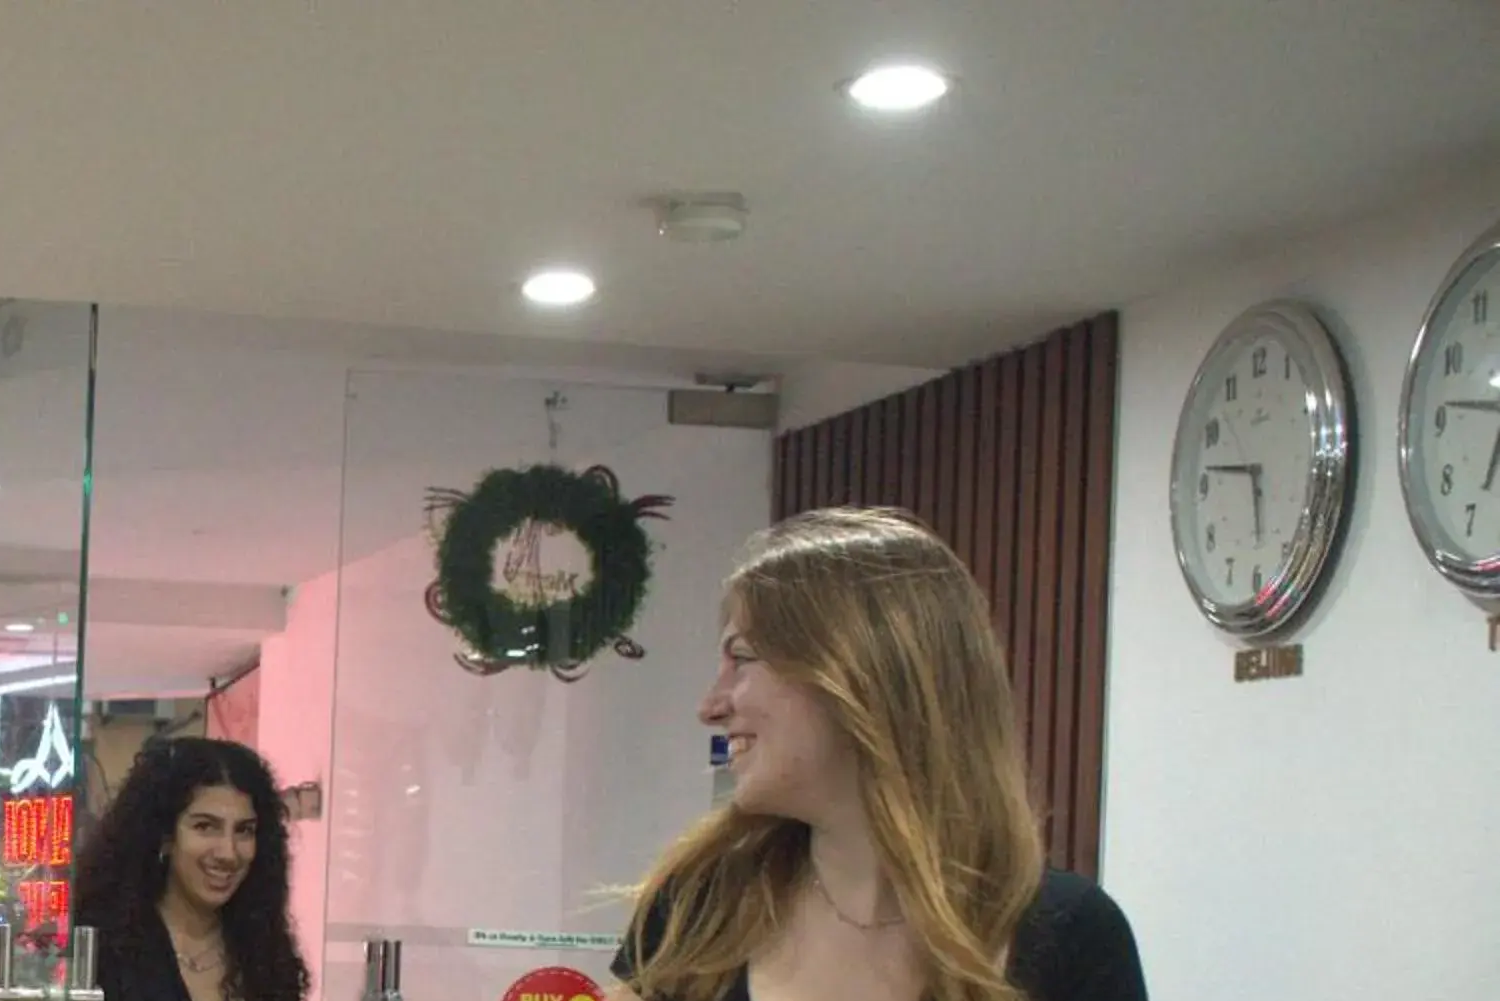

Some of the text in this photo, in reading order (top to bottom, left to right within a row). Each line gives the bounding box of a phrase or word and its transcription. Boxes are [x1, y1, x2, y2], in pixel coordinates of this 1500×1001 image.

[1472, 290, 1488, 325] 11
[1252, 347, 1268, 379] 12
[1444, 341, 1463, 377] 10
[1225, 373, 1238, 402] 11
[1435, 405, 1447, 438] 9
[1440, 464, 1455, 497] 8
[1464, 503, 1477, 538] 7
